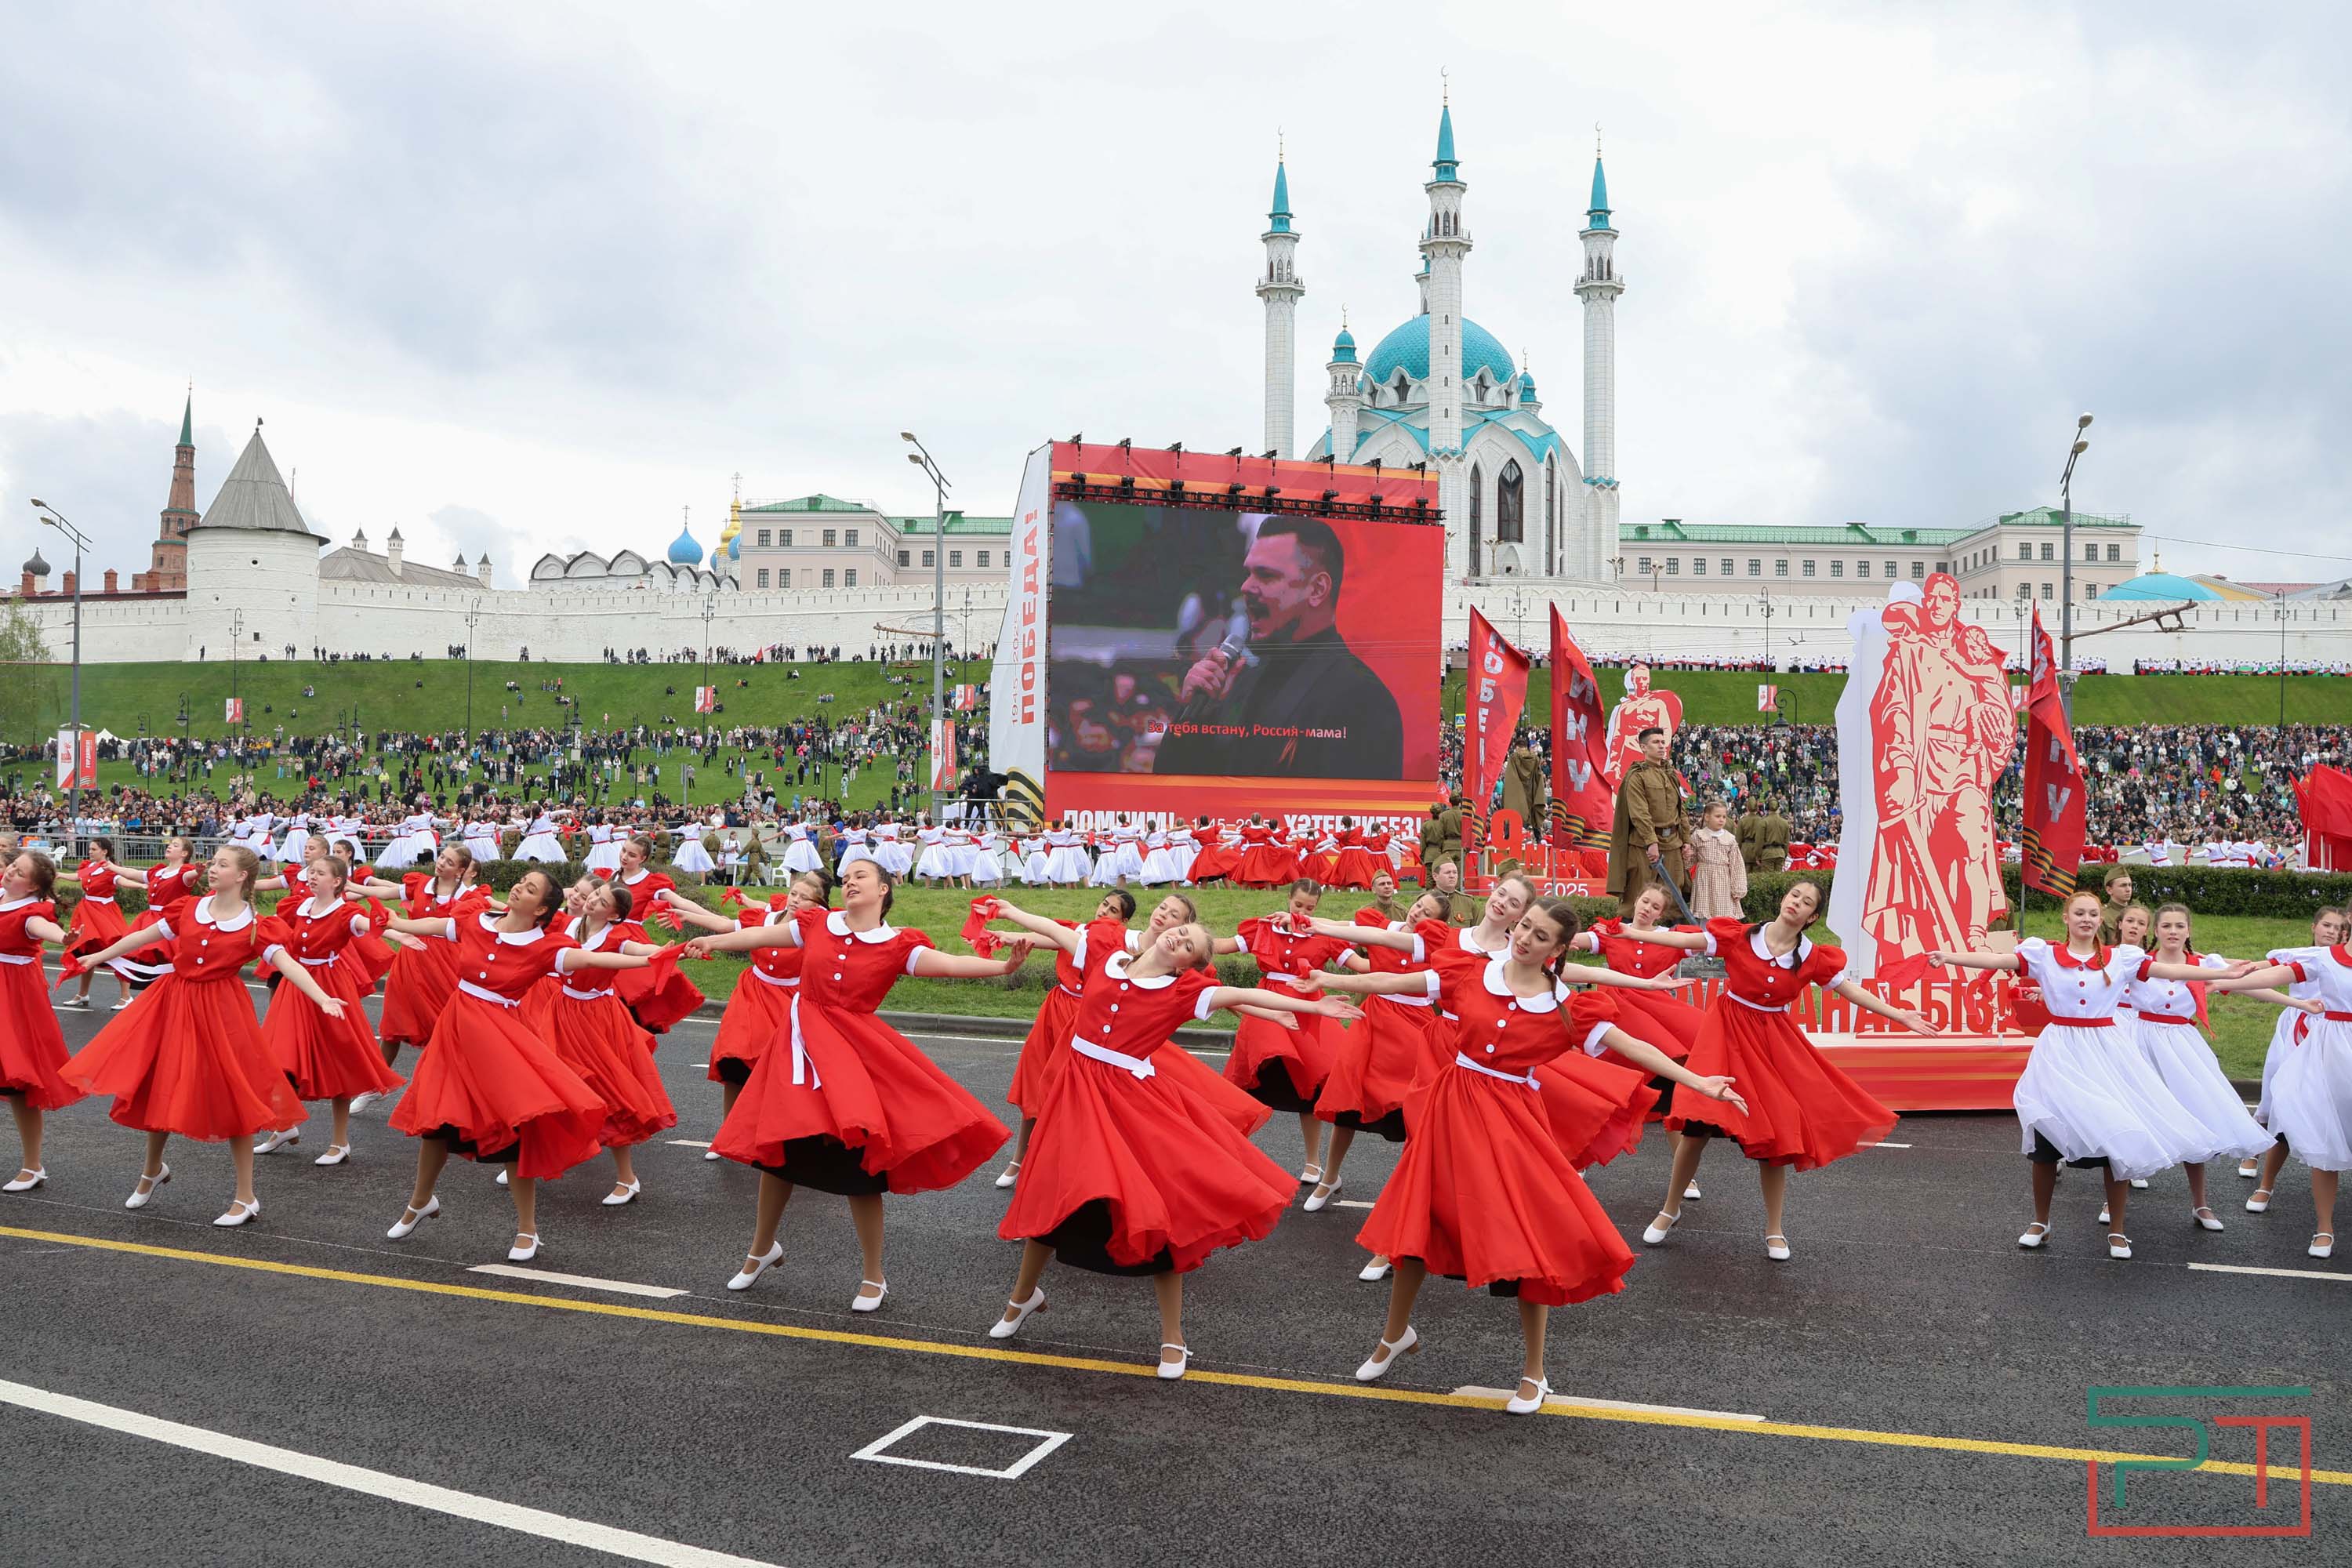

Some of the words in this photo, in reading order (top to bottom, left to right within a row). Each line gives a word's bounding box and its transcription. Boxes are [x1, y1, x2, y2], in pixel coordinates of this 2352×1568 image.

[1022, 508, 1039, 724] ПОБЕДА!
[1148, 720, 1164, 732] За
[1168, 721, 1198, 733] тебя
[1202, 724, 1249, 737] встану,
[1490, 809, 1523, 865] 9
